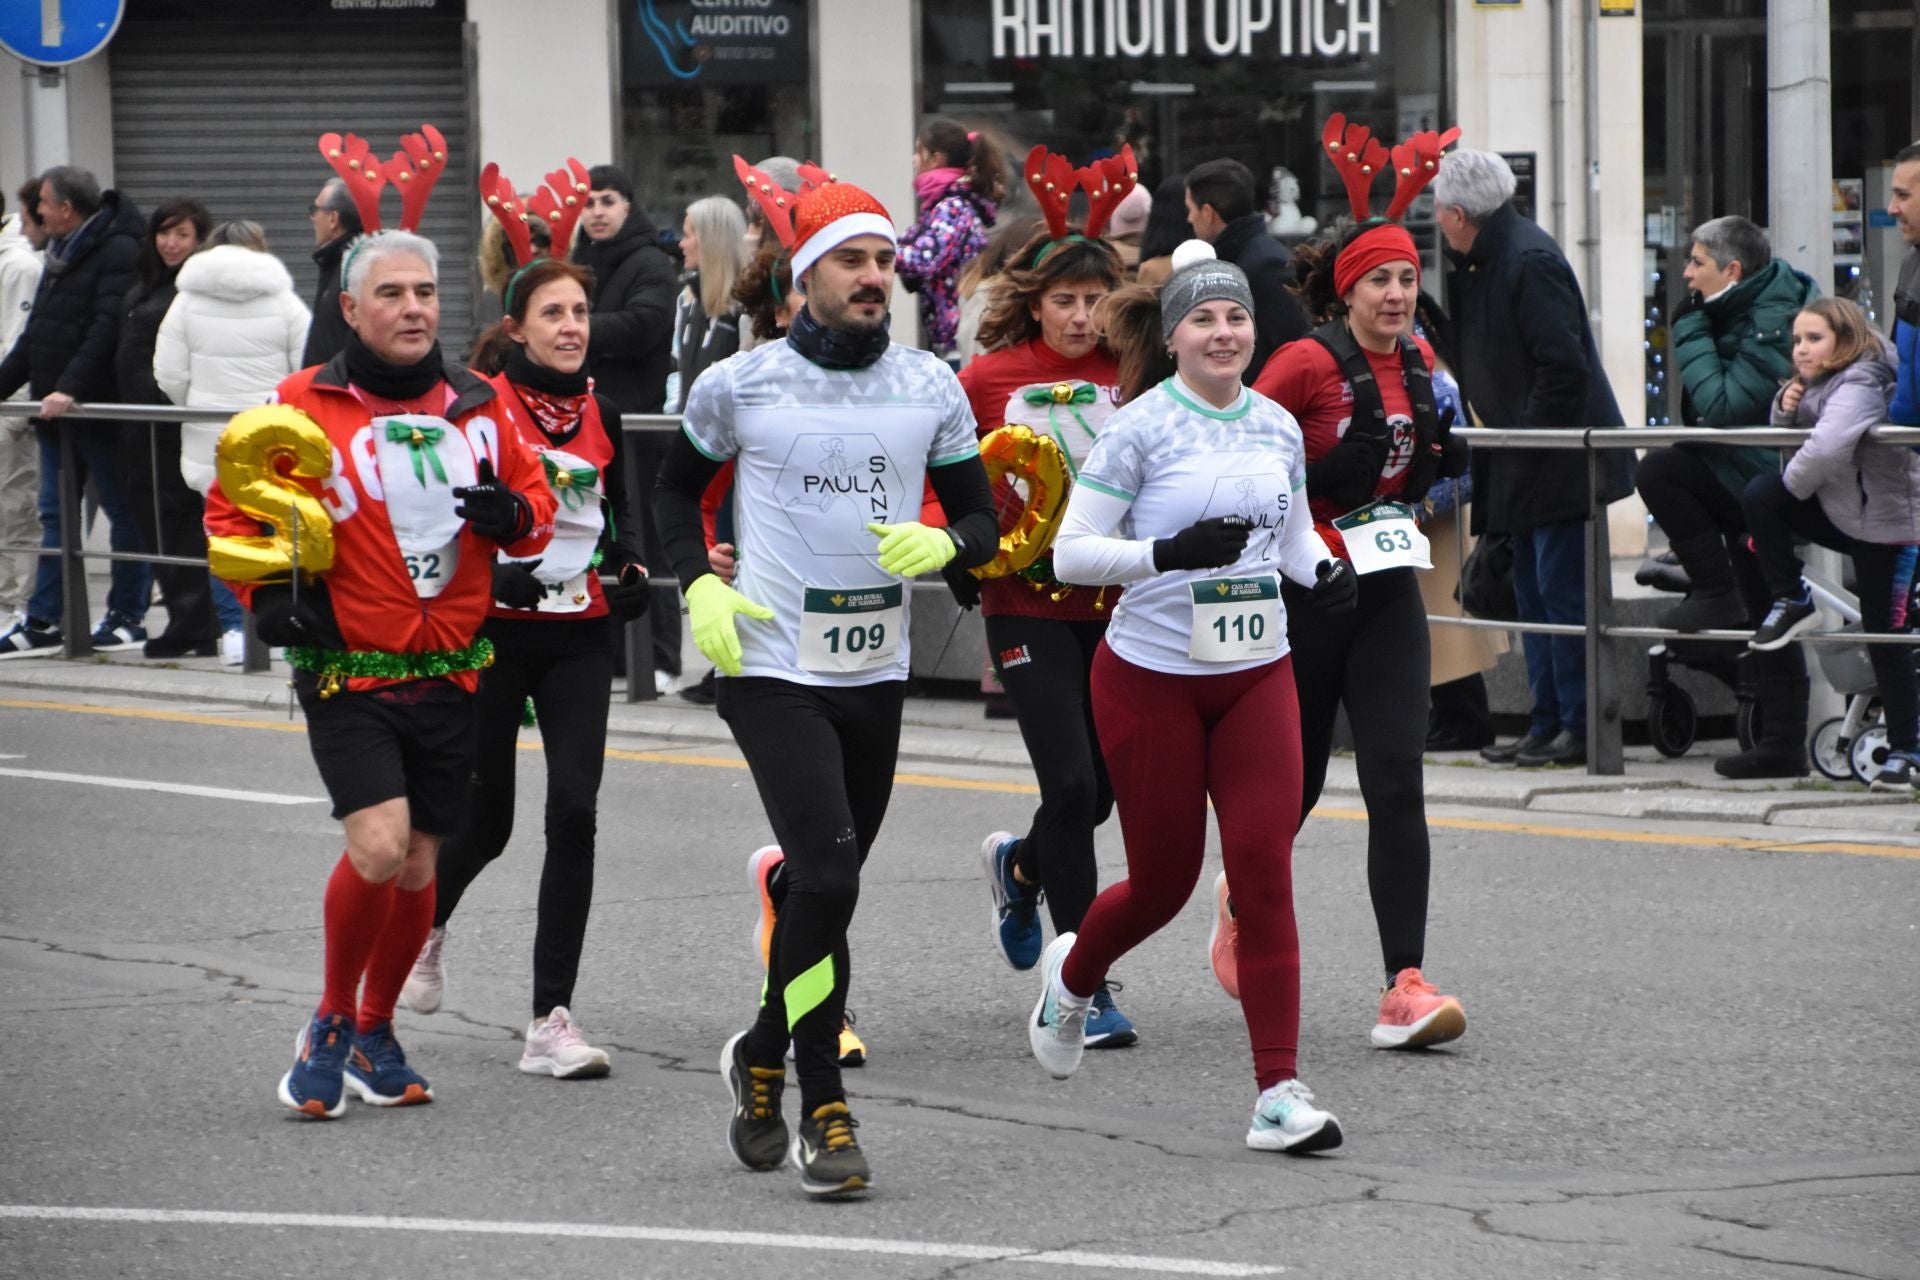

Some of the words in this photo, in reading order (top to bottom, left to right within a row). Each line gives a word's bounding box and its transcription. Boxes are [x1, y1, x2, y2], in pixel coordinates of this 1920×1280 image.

[691, 15, 789, 35] AUDITIVO
[803, 475, 886, 493] PAULA
[1375, 529, 1412, 553] 63
[405, 554, 440, 580] 62
[823, 623, 885, 653] 109
[1213, 613, 1264, 643] 110
